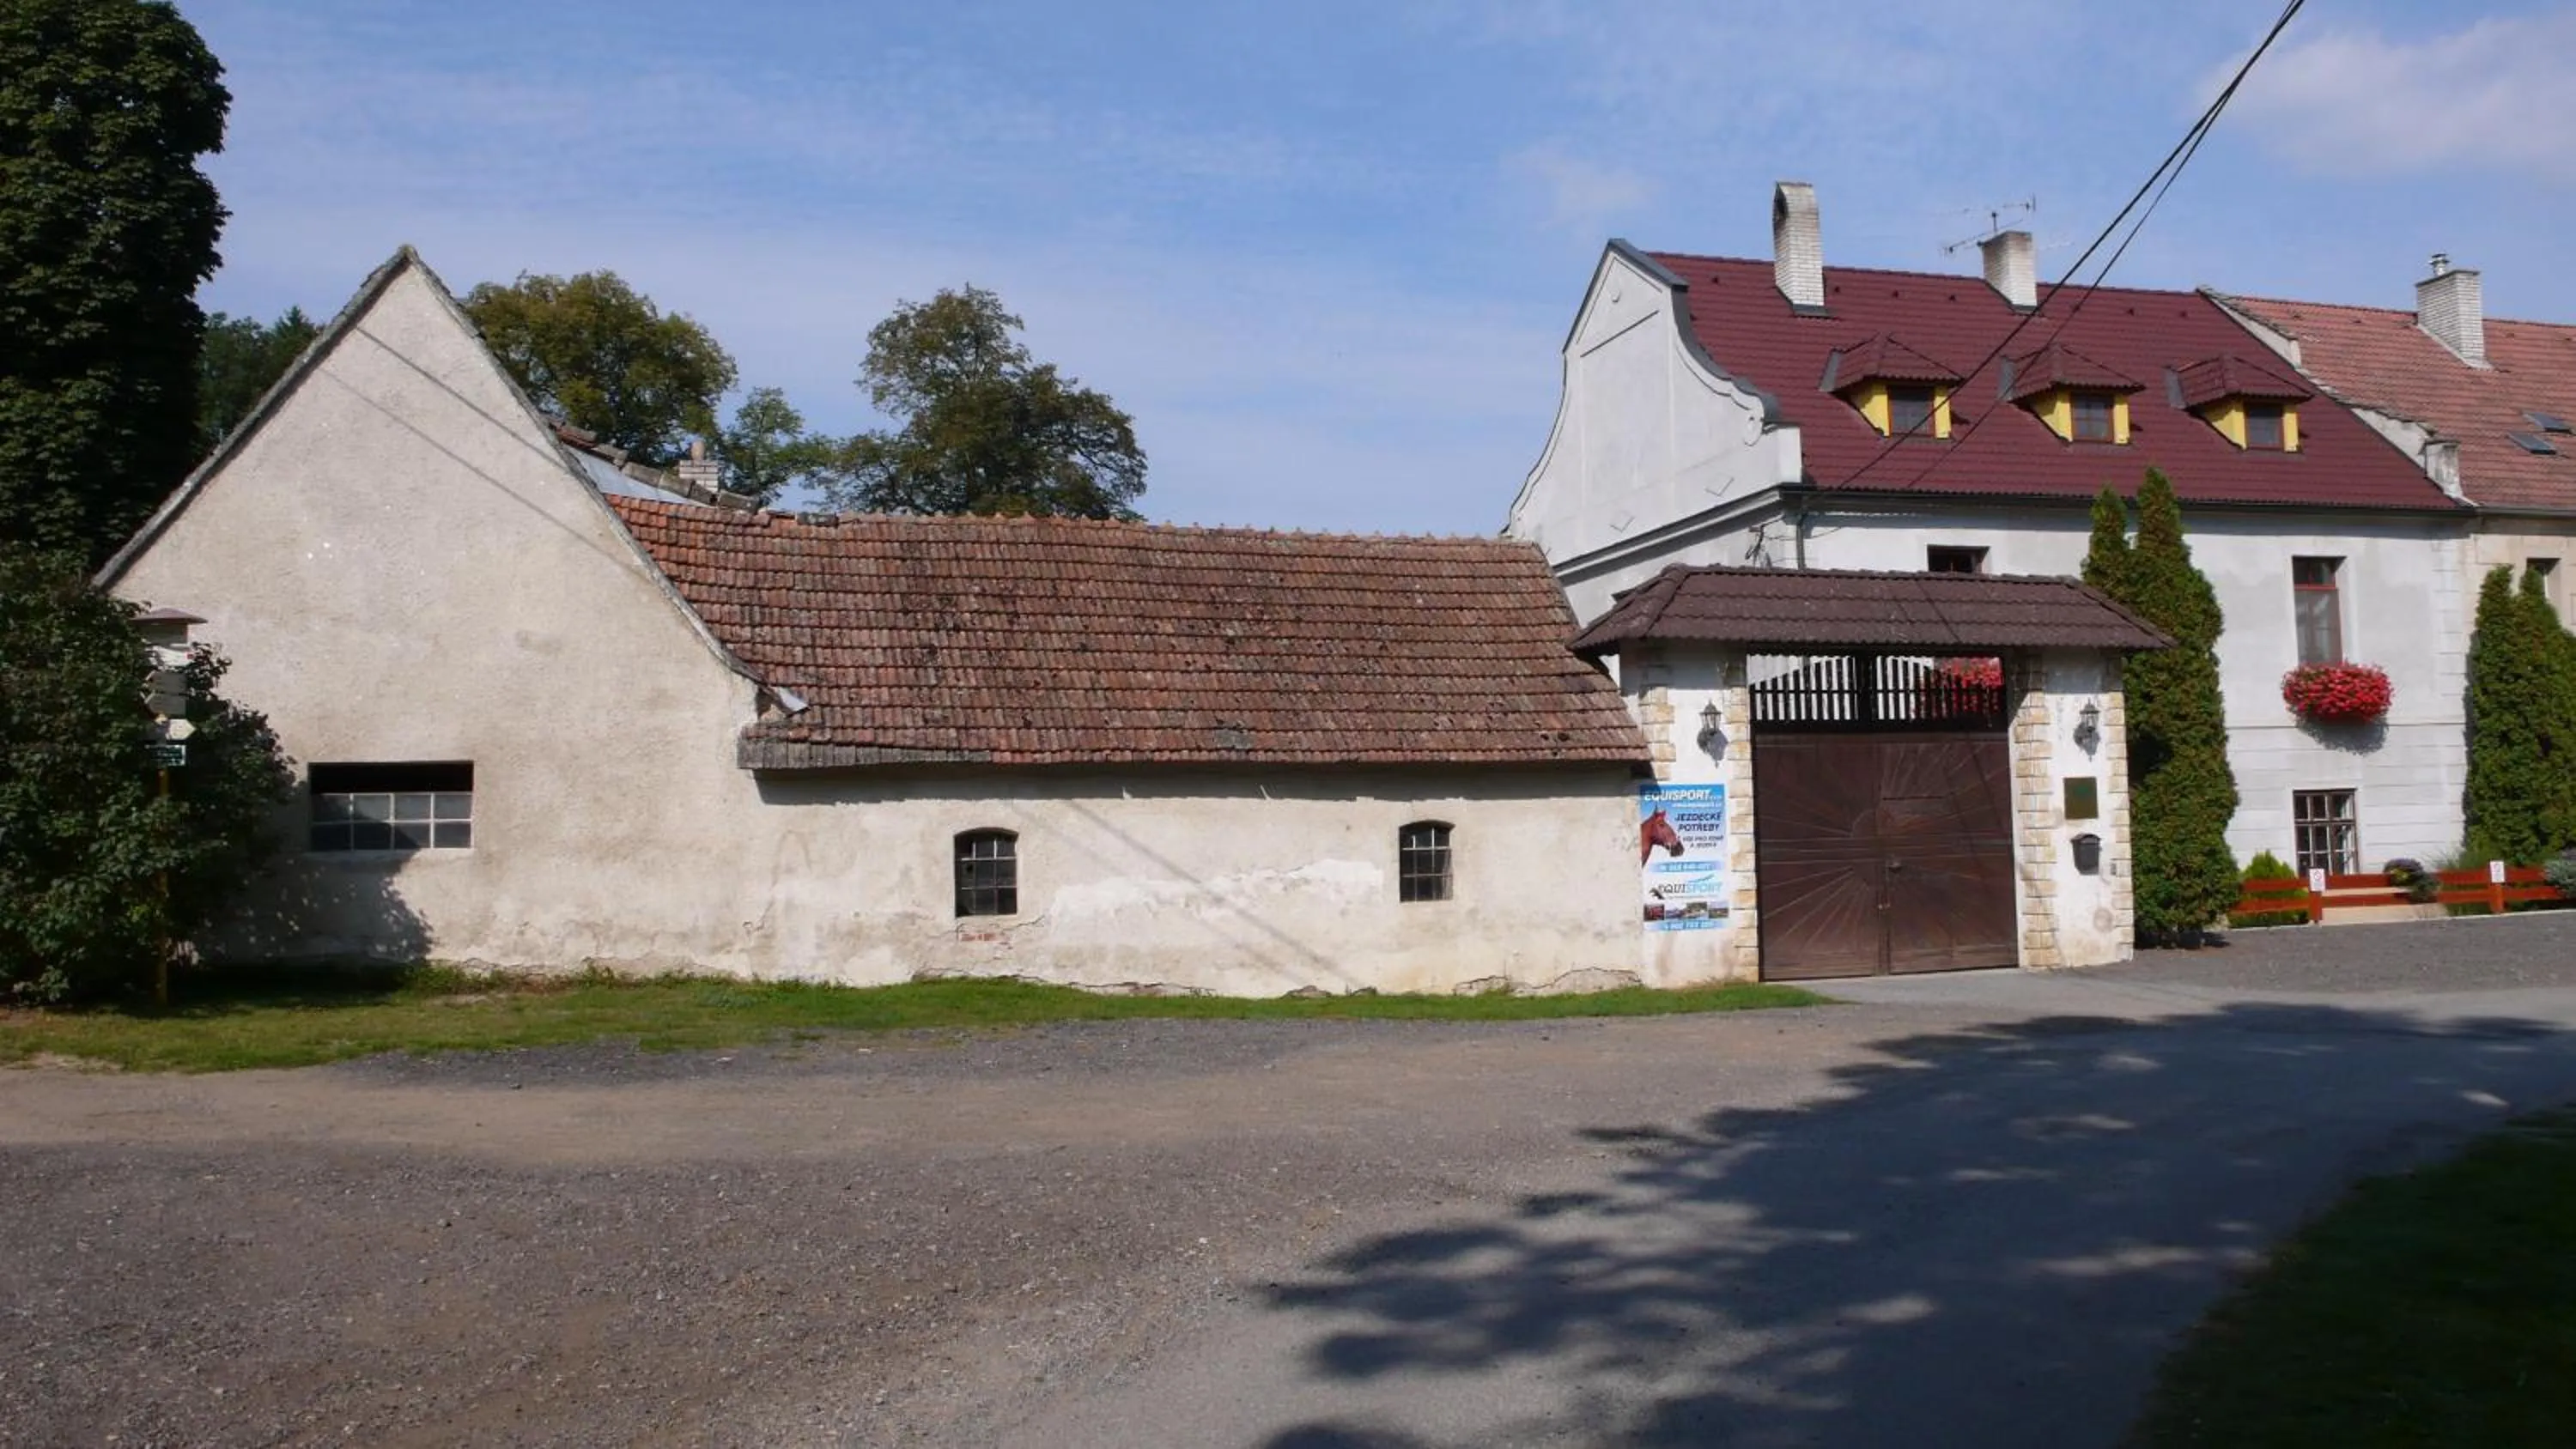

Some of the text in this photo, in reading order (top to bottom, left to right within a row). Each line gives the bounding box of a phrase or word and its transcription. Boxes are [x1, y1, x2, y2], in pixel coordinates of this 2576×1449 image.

[1643, 789, 1711, 801] EQUISPORT
[1674, 810, 1722, 822] JEZDECKÉ
[1677, 822, 1720, 832] POTŘEBY
